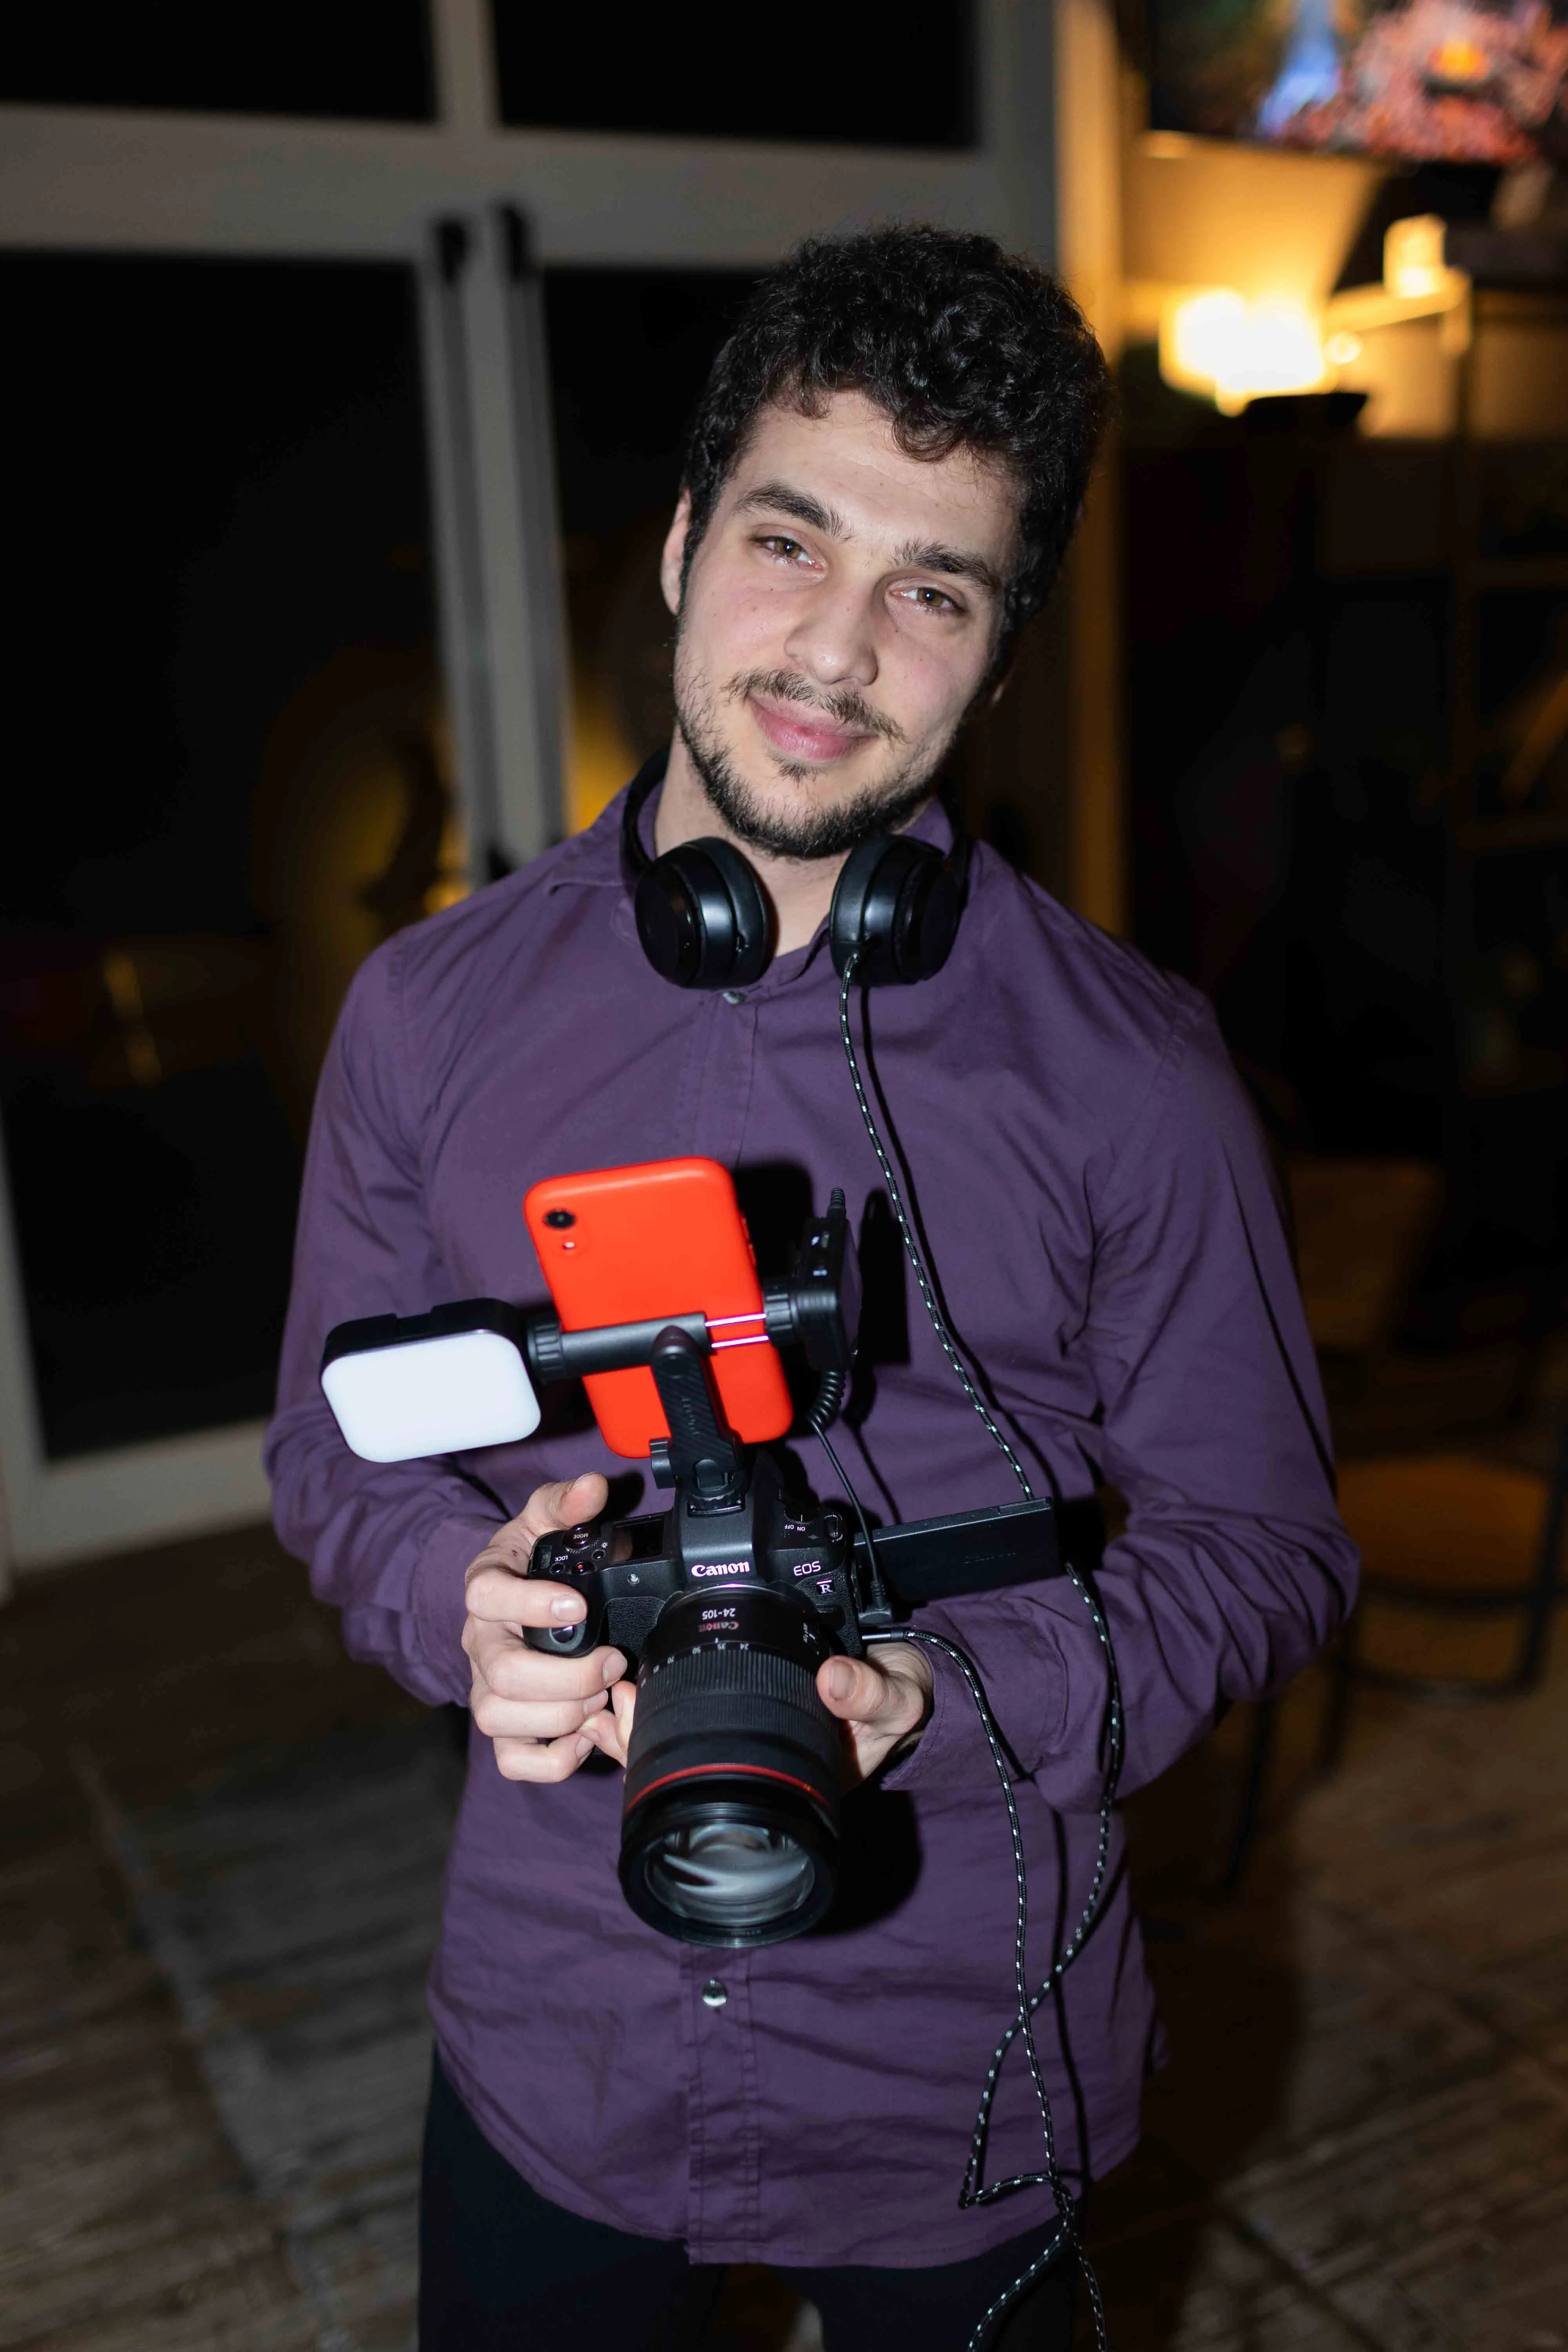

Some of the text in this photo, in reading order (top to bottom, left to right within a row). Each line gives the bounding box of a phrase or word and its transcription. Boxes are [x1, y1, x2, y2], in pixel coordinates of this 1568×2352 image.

[691, 1562, 750, 1577] Canon
[793, 1561, 821, 1576] EOS
[820, 1584, 833, 1593] R
[702, 1608, 735, 1620] 24-105
[698, 1622, 739, 1632] Canon
[692, 1646, 701, 1654] 50
